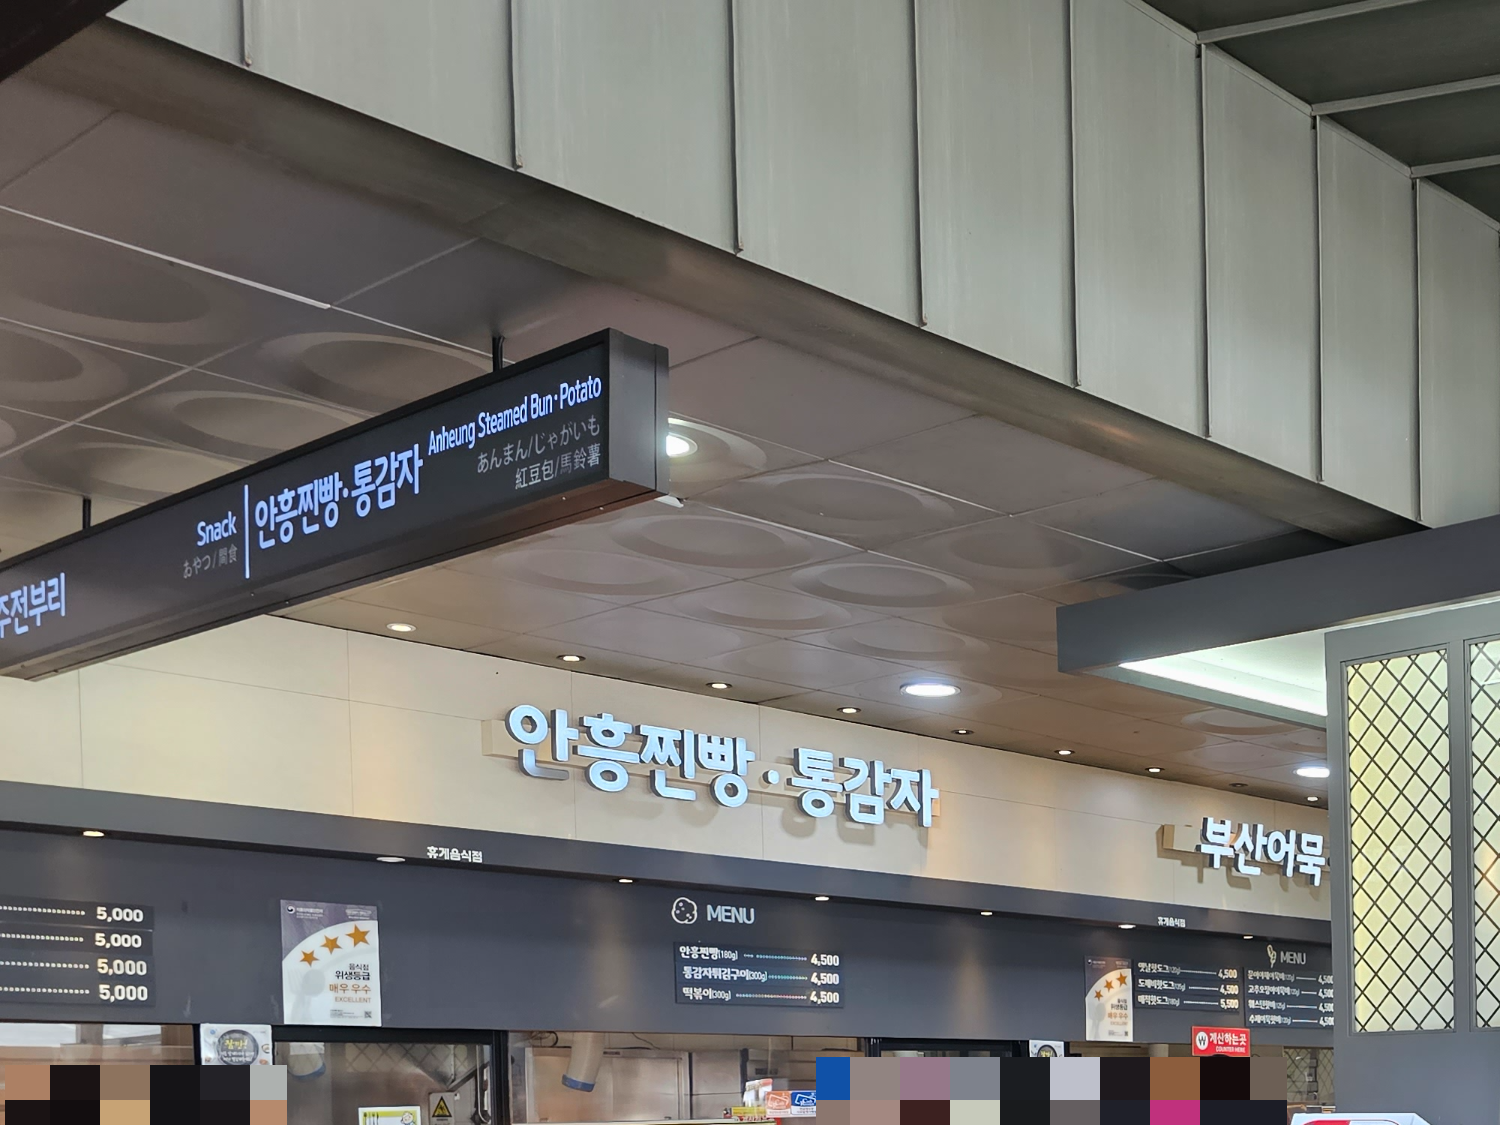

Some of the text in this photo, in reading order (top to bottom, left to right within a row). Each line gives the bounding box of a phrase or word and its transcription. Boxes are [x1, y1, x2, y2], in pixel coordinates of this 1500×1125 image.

[428, 420, 476, 456] Anheung
[477, 396, 528, 438] Steamed
[196, 511, 237, 546] Snack
[426, 845, 483, 864] 휴게음식점
[1200, 816, 1326, 887] 부산어묵
[96, 906, 144, 922] 5,000
[706, 904, 755, 924] MENU
[95, 932, 142, 948] 5,000
[810, 954, 840, 967] 4,500
[1280, 951, 1307, 965] MENU
[97, 958, 147, 976] 5,000
[1218, 968, 1238, 979] 4,500
[335, 971, 371, 981] 위생등급
[810, 972, 840, 986] 4,500
[99, 984, 148, 1003] 5,000
[329, 983, 371, 994] 매우 우수
[1219, 984, 1239, 995] 4,500
[810, 991, 840, 1004] 4,500
[1220, 998, 1239, 1009] 5,500
[1209, 1032, 1247, 1046] 계산하는곳
